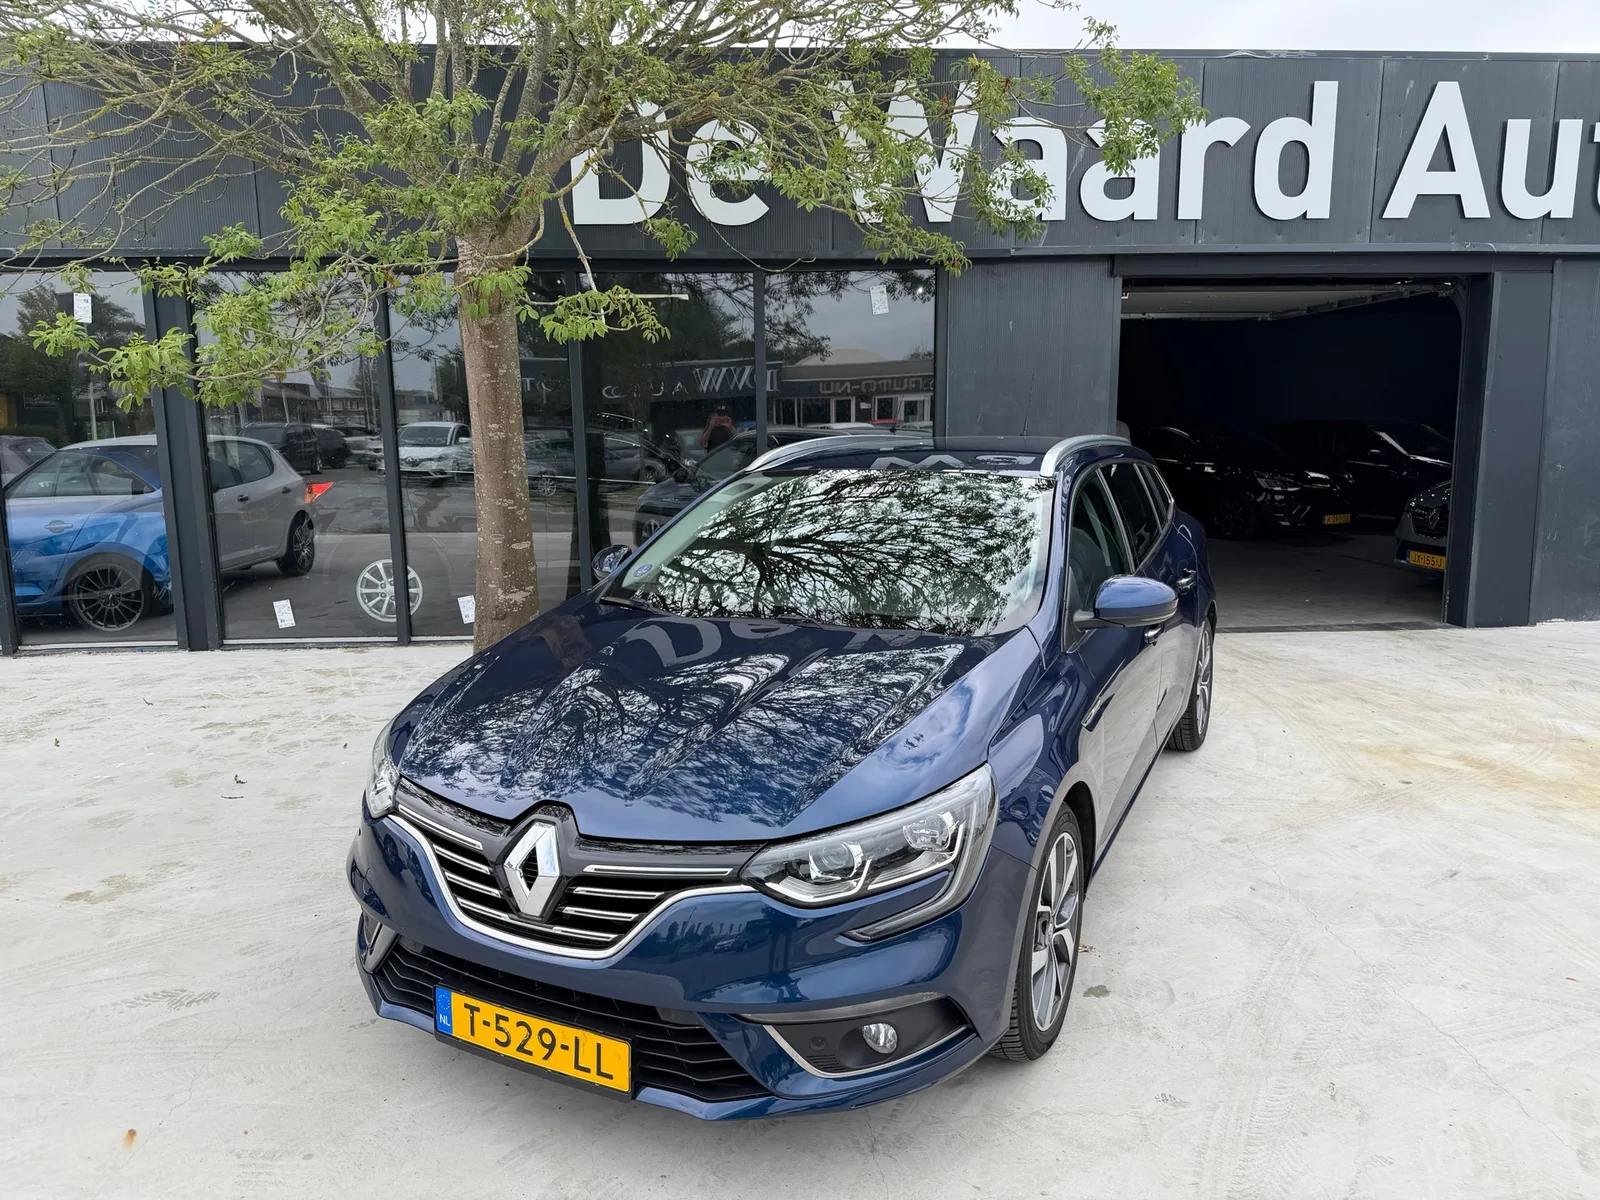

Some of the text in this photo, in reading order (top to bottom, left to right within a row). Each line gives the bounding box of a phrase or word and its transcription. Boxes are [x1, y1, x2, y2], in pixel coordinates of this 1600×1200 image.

[570, 80, 1600, 226] De Waard Au
[1413, 552, 1443, 568] JX-155-J
[439, 1013, 451, 1027] NL
[463, 1002, 614, 1081] T-529-LL
